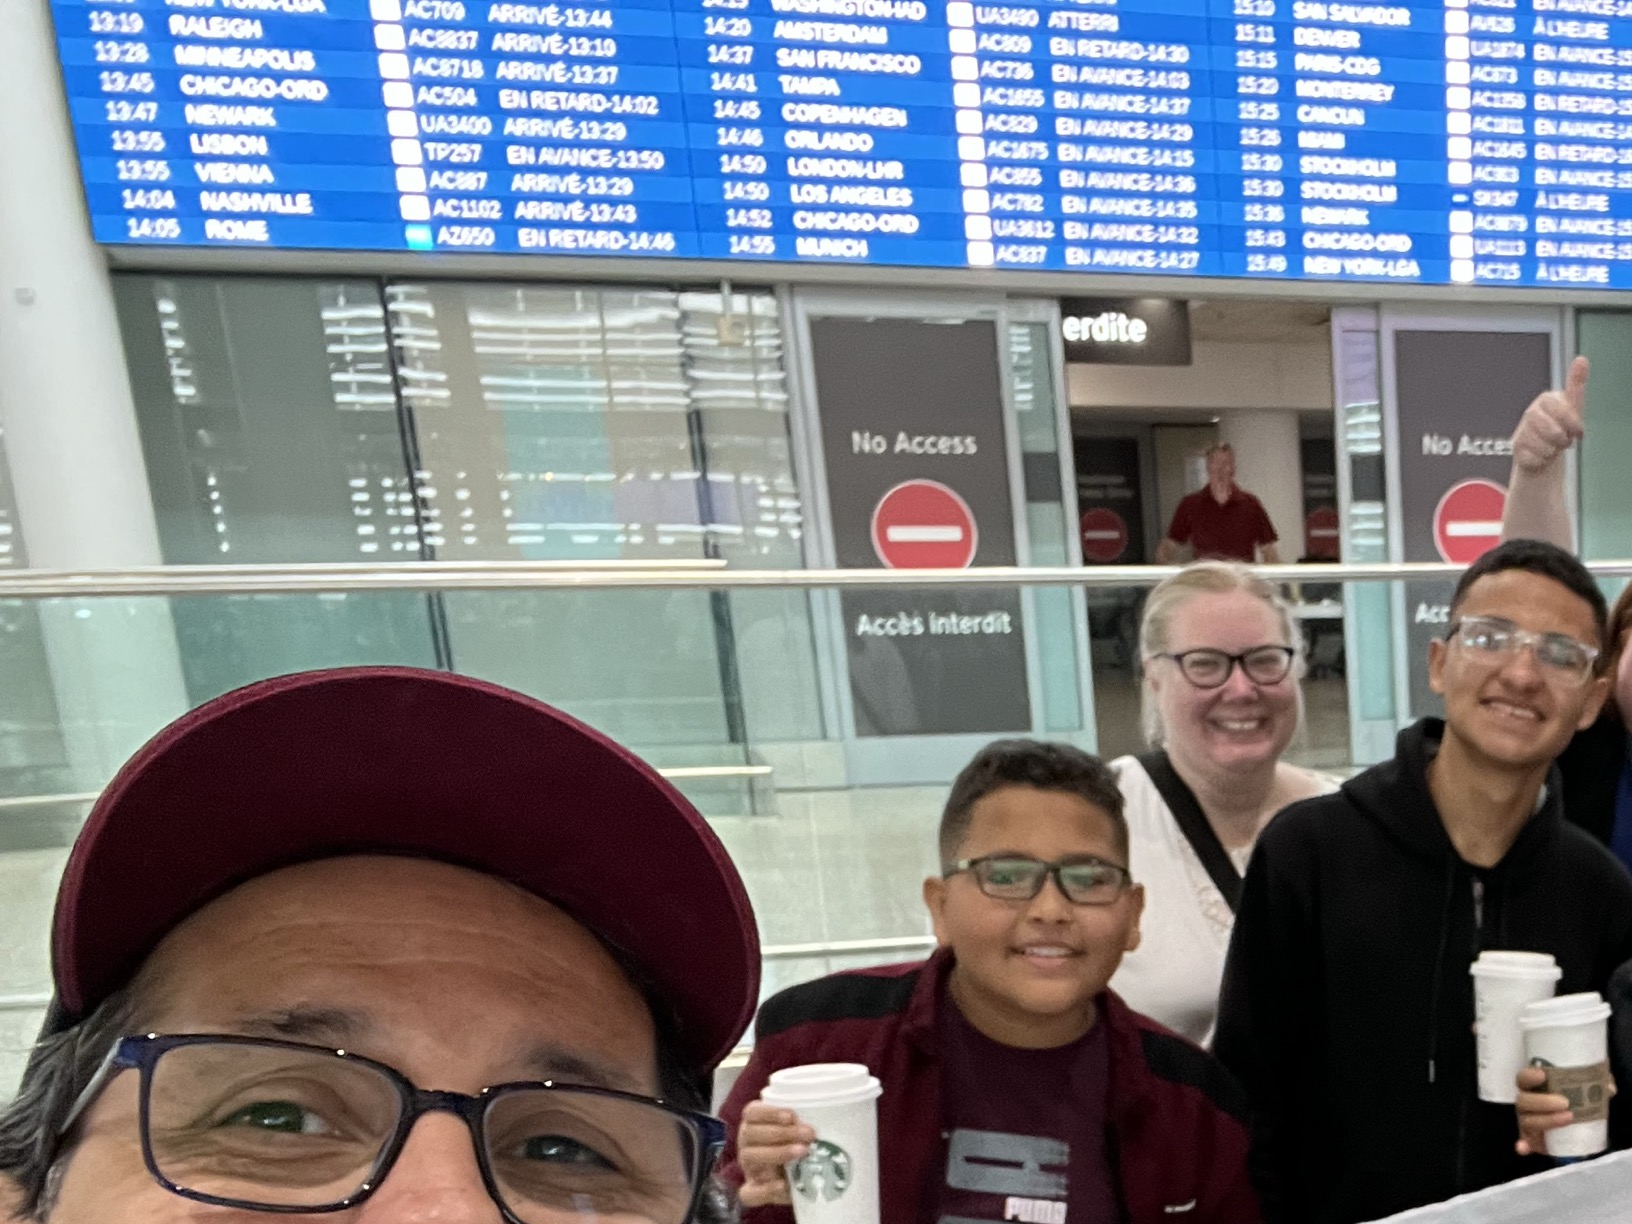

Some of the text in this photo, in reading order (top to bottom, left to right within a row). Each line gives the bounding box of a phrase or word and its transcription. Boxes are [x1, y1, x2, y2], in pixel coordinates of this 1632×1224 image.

[1293, 1, 1328, 20] SAN
[169, 14, 263, 39] RALEIGH
[774, 20, 888, 44] AMSTERDAM
[1050, 37, 1076, 56] EN
[1294, 27, 1360, 48] DENVER
[174, 45, 315, 71] MINNEAPOLIS
[776, 48, 816, 68] SAN
[817, 51, 921, 74] FRANCISCO
[1052, 64, 1078, 82] EN
[1295, 53, 1380, 75] PARIS-CDG
[180, 74, 328, 101] CHICAGO-ORD
[499, 89, 528, 109] EN
[778, 75, 840, 96] TAMPA
[1054, 90, 1079, 109] EN
[1296, 79, 1394, 102] MONTERREY
[107, 101, 157, 121] 13:47
[185, 104, 276, 127] NEWARK
[782, 103, 907, 127] COPENHAGEN
[1056, 117, 1082, 135] EN
[1297, 105, 1365, 125] CANCUN
[190, 134, 268, 155] LISBON
[507, 145, 536, 164] EN
[784, 130, 874, 152] ORLANDO
[1057, 143, 1083, 162] EN
[195, 162, 274, 184] VIENNA
[787, 157, 903, 179] LONDON-LHR
[1060, 169, 1085, 188] EN
[200, 191, 313, 214] NASHVILLE
[790, 184, 829, 204] LOS
[830, 187, 913, 207] ANGELES
[1062, 195, 1087, 213] EN
[205, 219, 269, 242] ROME
[518, 228, 547, 248] EN
[793, 211, 919, 233] CHICAGO-ORD
[1063, 221, 1089, 240] EN
[796, 237, 868, 259] MUNICH
[1065, 247, 1091, 265] EN
[1303, 231, 1412, 252] CHICAGO-ORD
[1304, 256, 1342, 279] NEW
[852, 430, 978, 454] No Access
[1421, 433, 1453, 455] No
[856, 611, 924, 636] Accès
